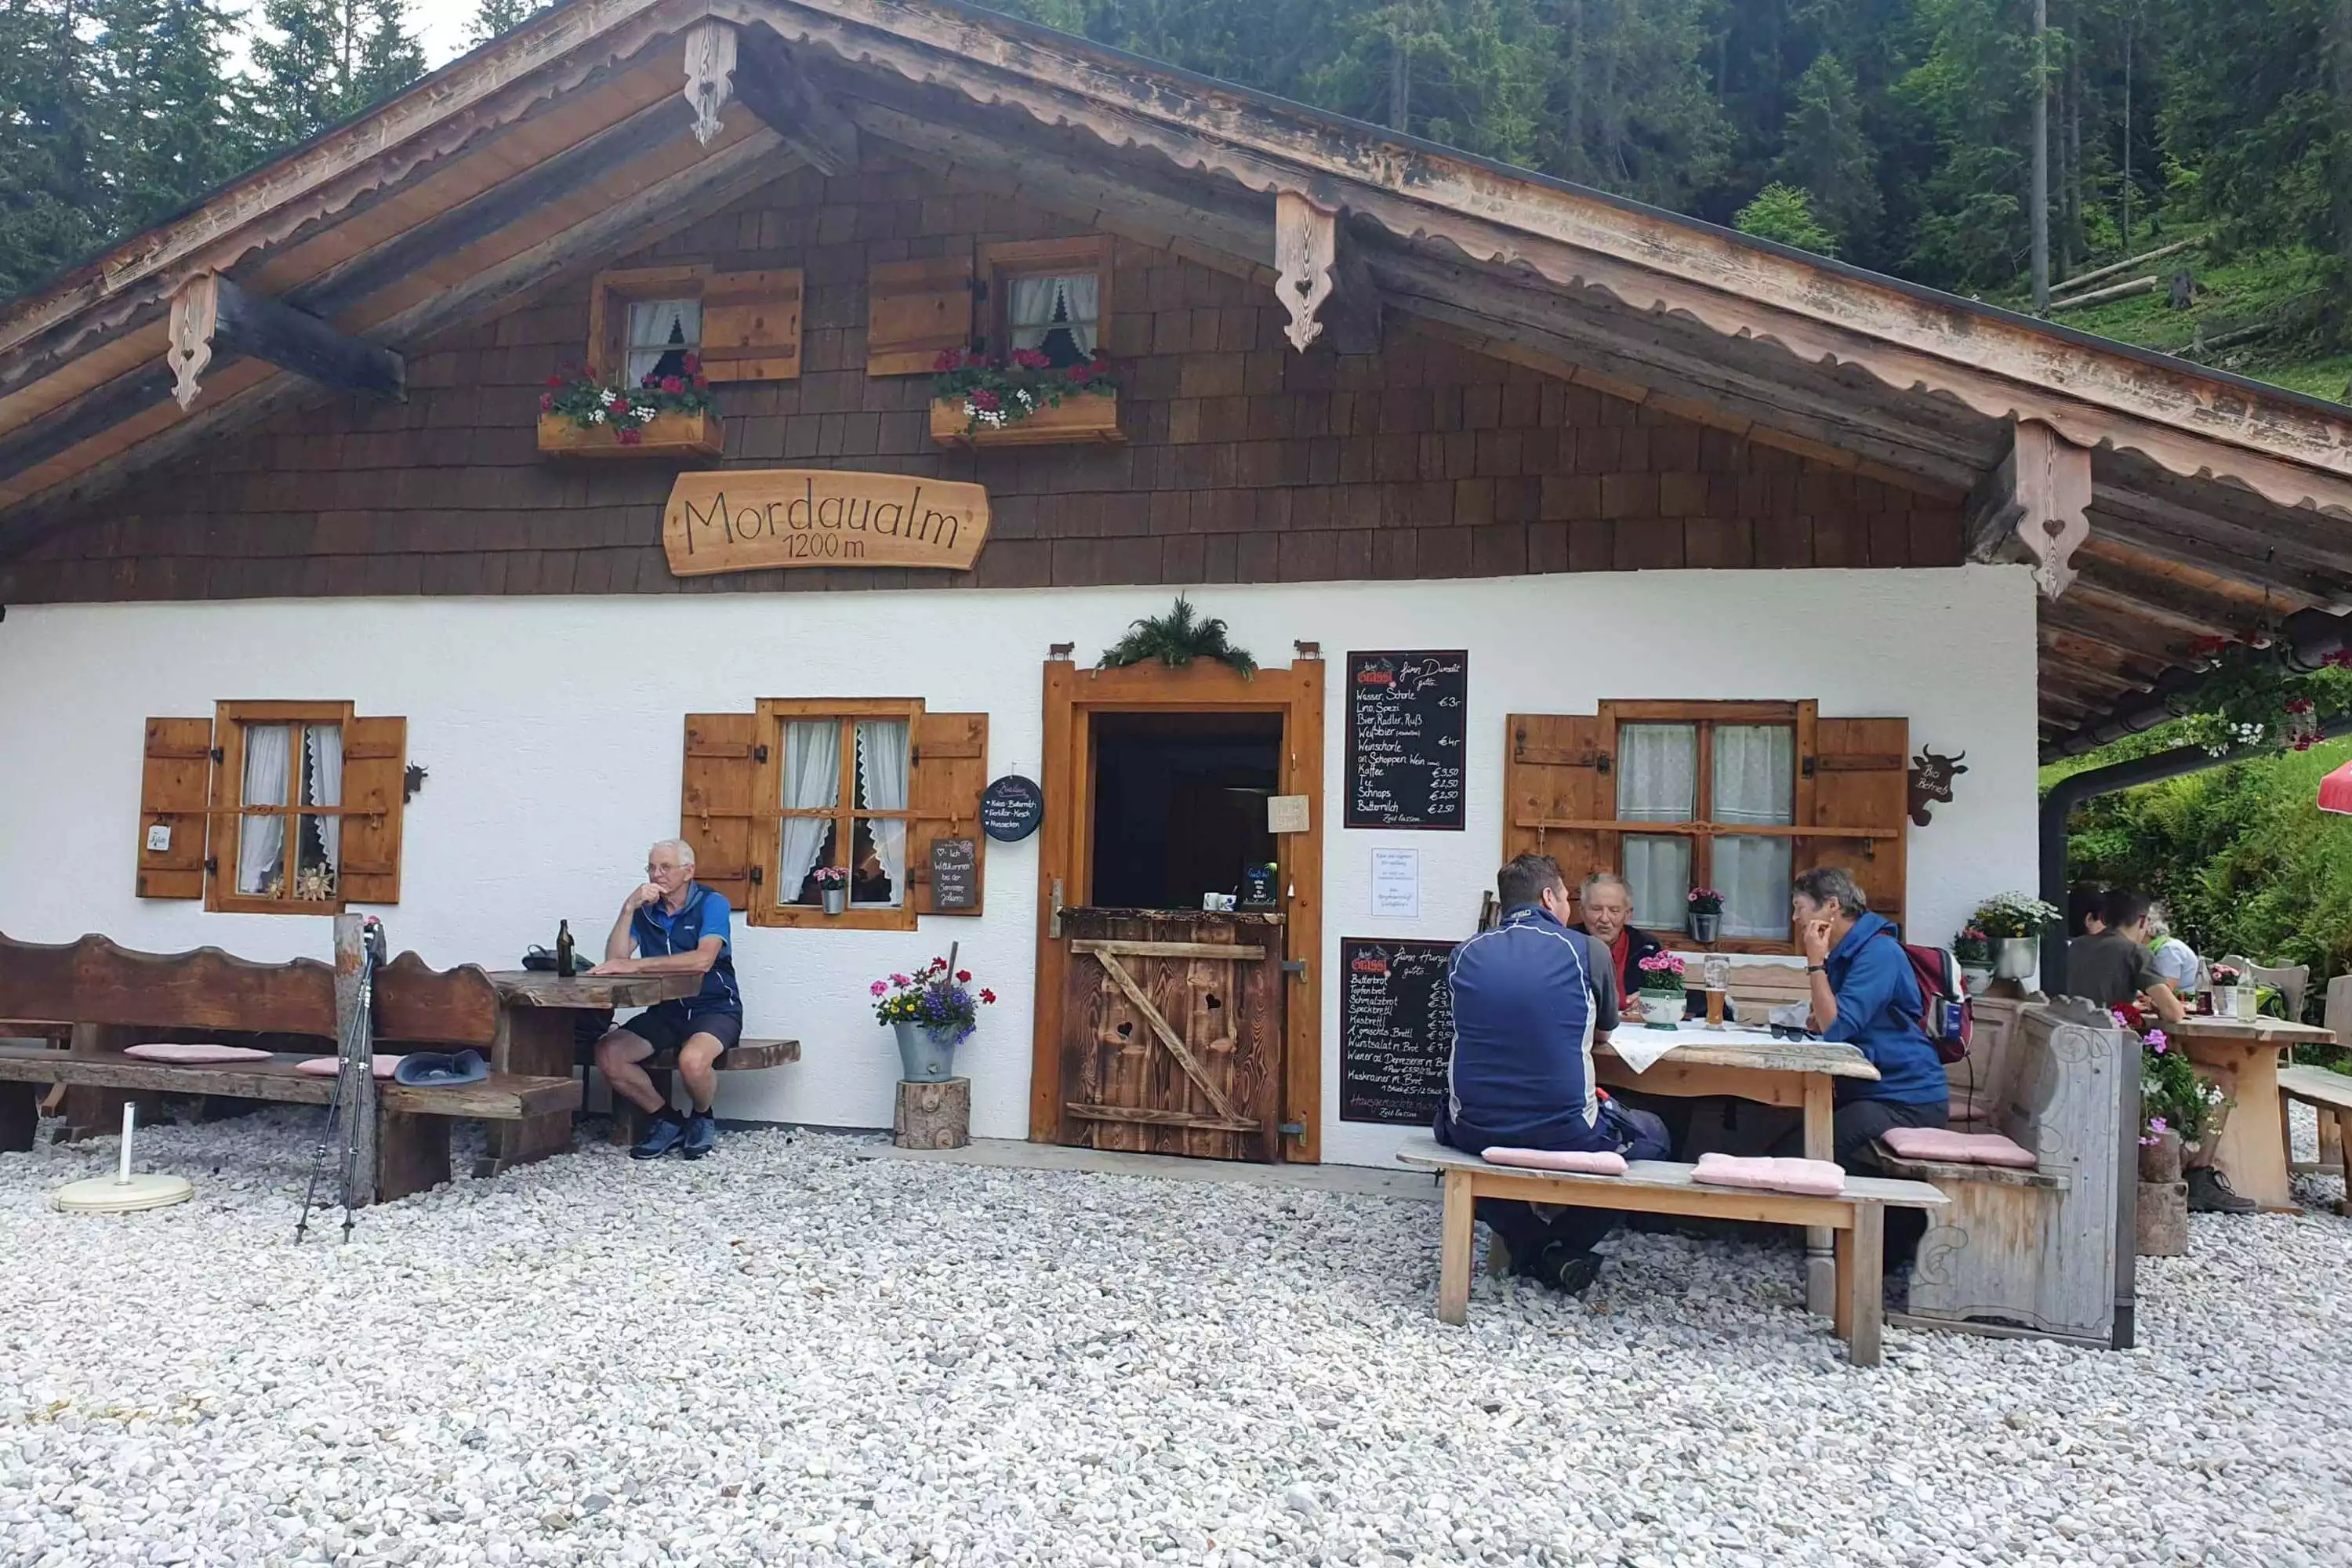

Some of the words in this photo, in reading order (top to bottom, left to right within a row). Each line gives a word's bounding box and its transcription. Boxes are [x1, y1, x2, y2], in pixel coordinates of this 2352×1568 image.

[684, 477, 959, 555] Mordaualm
[782, 533, 838, 558] 1200
[844, 538, 865, 558] m
[1386, 687, 1417, 700] Schorle
[1376, 702, 1400, 714] Spezi
[1358, 739, 1403, 753] Weinschorle
[1368, 752, 1407, 767] Schoppen
[1410, 753, 1425, 766] Wein
[1358, 764, 1385, 778] Kaffee
[1922, 764, 1940, 778] Bio
[1359, 775, 1374, 787] Tee
[1357, 786, 1392, 799] Schnaps
[1356, 800, 1399, 813] Buttermilch
[1419, 949, 1450, 967] Hunge
[1350, 974, 1388, 985] Butterbrot
[1349, 994, 1398, 1006] Schmalzbrot
[1348, 1036, 1392, 1050] Wurstsalat
[1402, 1041, 1421, 1052] Brot
[1347, 1050, 1371, 1061] Wiener
[1401, 1073, 1424, 1085] Brot
